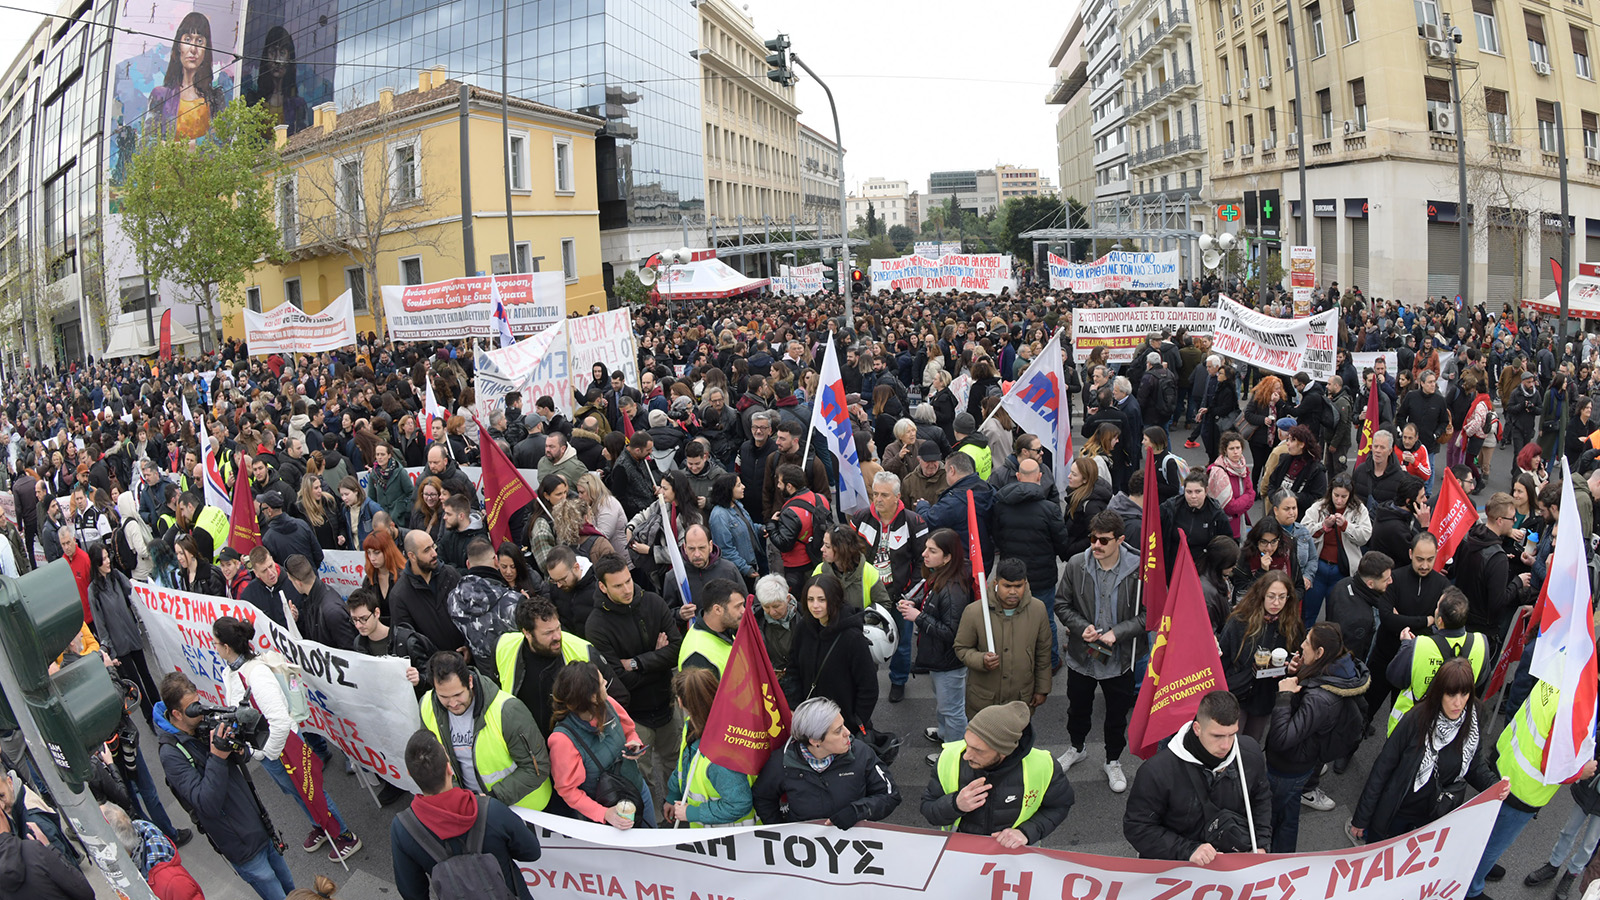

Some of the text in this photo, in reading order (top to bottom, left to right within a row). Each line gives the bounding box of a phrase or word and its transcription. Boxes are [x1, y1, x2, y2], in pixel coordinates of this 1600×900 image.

[1545, 218, 1571, 228] EUROBK
[881, 260, 890, 270] ΤΟ
[950, 256, 970, 266] ΔΡΟΜΟ
[972, 256, 980, 267] ΘΑ
[1076, 268, 1084, 278] ΘΑ
[441, 282, 466, 294] αγώνα
[467, 282, 482, 291] για
[483, 279, 530, 291] μρφωση,
[926, 276, 957, 289] ΣΥΛΛΟΓΟΙ
[960, 276, 990, 290] ΑΘΗΝΑΣ
[446, 293, 461, 304] ζωή
[514, 306, 558, 318] ΑΓΩΝΙΖΟΝΤΑΙ
[1079, 310, 1217, 322] ΣΥΣΠΕΙΡΩΝΟΜΑΣΤΕ ΣΤΟ ΣΩΜΑΤΕΙΟ ΜΑ
[1078, 324, 1120, 334] ΠΑΛΕΥΟΥΜΕ
[1122, 324, 1134, 333] ΓΙΑ
[1136, 324, 1164, 332] ΔΟΥΛΕΙΑ
[1180, 324, 1216, 333] ΔΙΚΑΙΩΜΑΤ
[1219, 316, 1230, 330] ΤΟ
[1078, 338, 1115, 347] ΔΙΕΚΔΙΚΟΥΜΕ
[1212, 331, 1240, 353] ΞΥΓΟΝΟ
[158, 592, 218, 625] ΣΥΣΤΗΜΑ
[270, 622, 358, 689] ΚΕΡΔΟΥΣ
[727, 724, 766, 740] ΣΥΝΔΙΚΑΤΟ
[724, 734, 764, 750] ΤΟΥΡΙΣΜΟΥ
[754, 830, 885, 876] ΤΟΥΣ
[1324, 826, 1451, 900] ΜΑΣ!
[520, 868, 628, 900] ΟΥΛΕΙΑ
